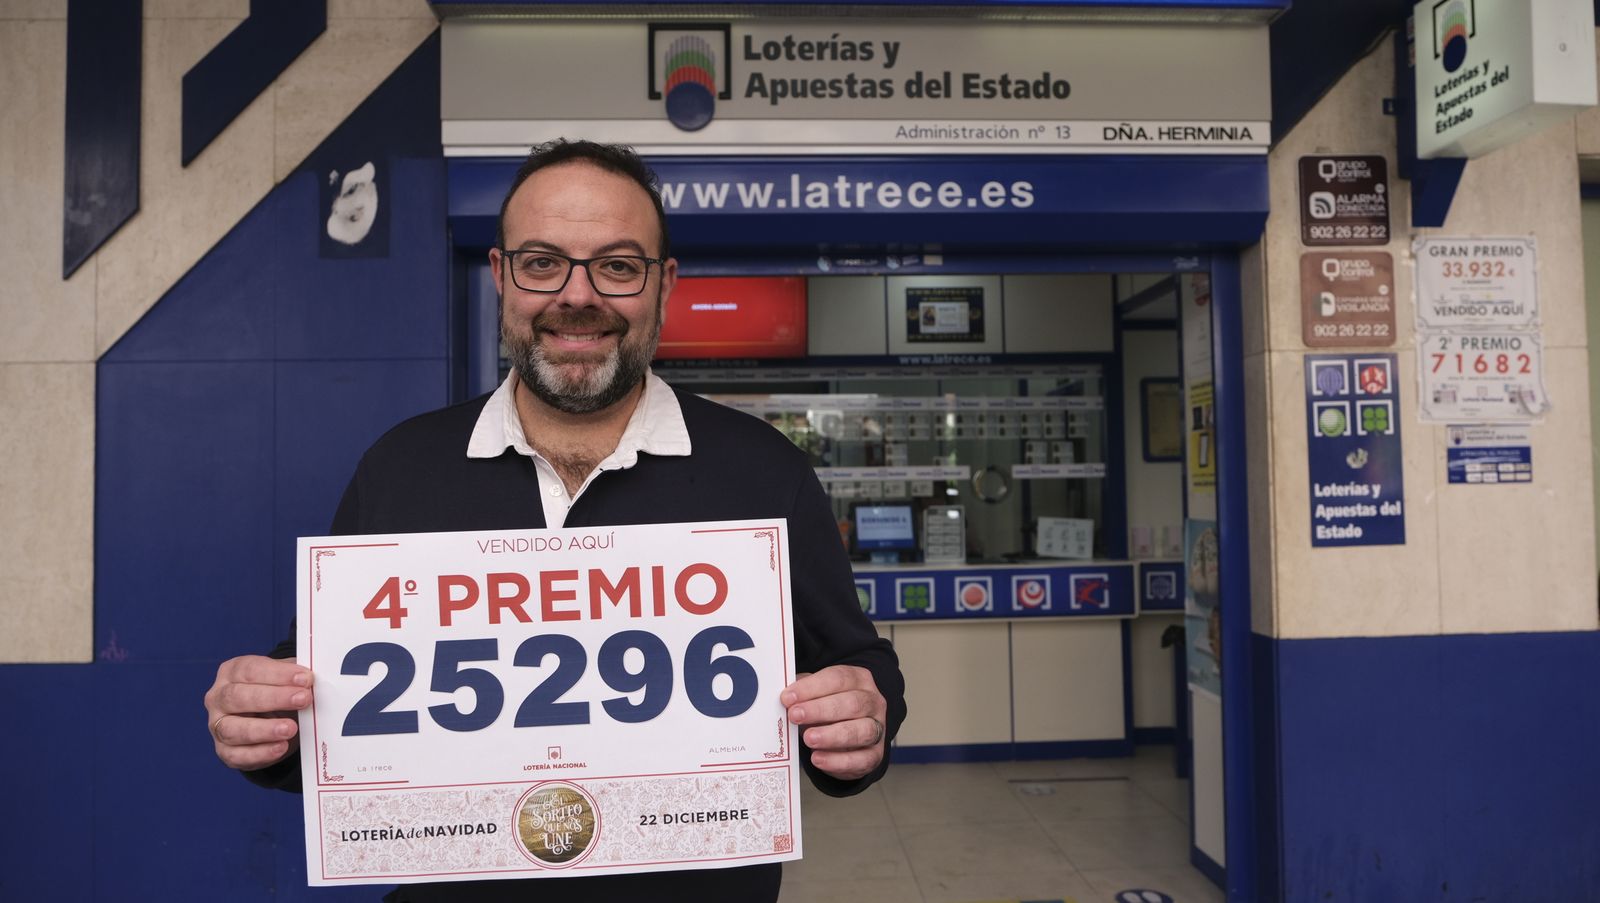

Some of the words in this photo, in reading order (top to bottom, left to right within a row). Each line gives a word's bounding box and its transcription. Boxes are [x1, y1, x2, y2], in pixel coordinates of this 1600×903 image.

[743, 35, 876, 62] Loterías
[884, 41, 900, 68] y
[1434, 65, 1479, 98] Loterías
[1482, 59, 1490, 76] y
[745, 73, 893, 105] Apuestas
[904, 70, 953, 100] del
[962, 70, 1071, 100] Estado
[1436, 81, 1487, 116] Apuestas
[1491, 65, 1509, 87] del
[1436, 107, 1473, 134] Estado
[895, 124, 1019, 139] Administración
[1056, 125, 1071, 139] 13
[1102, 123, 1154, 141] DÑA.
[1158, 126, 1253, 141] HERMINIA
[1337, 161, 1367, 170] grupo
[1337, 168, 1372, 178] control
[661, 173, 1034, 209] www.latrece.es
[1337, 194, 1386, 203] ALARMA
[1310, 225, 1334, 239] 902
[1335, 225, 1352, 239] 26
[1353, 225, 1369, 238] 22
[1370, 225, 1386, 238] 22
[1429, 246, 1468, 257] GRAN
[1474, 246, 1524, 257] PREMIO
[1340, 259, 1370, 269] grupo
[1341, 267, 1375, 277] control
[1442, 262, 1506, 278] 33.932
[1337, 303, 1390, 312] VIGILANCIA
[1433, 305, 1487, 317] VENDIDO
[1492, 303, 1524, 316] AQUÍ
[1314, 324, 1337, 337] 902
[1339, 324, 1355, 337] 26
[1356, 324, 1372, 337] 22
[1373, 323, 1389, 337] 22
[1461, 337, 1522, 350] PREMIO
[1314, 482, 1370, 499] Loterías
[1372, 484, 1381, 500] y
[1315, 504, 1377, 521] Apuestas
[1380, 500, 1401, 516] del
[1316, 524, 1363, 540] Estado
[477, 537, 563, 554] VENDIDO
[568, 531, 615, 550] AQUÍ
[362, 577, 418, 629] 4º
[437, 562, 729, 627] PREMIO
[340, 625, 759, 737] 25296
[523, 763, 552, 771] LOTERÍA
[639, 814, 657, 826] 22
[663, 809, 749, 825] DICIEMBRE
[543, 821, 563, 833] QUE
[539, 831, 574, 855] UNE
